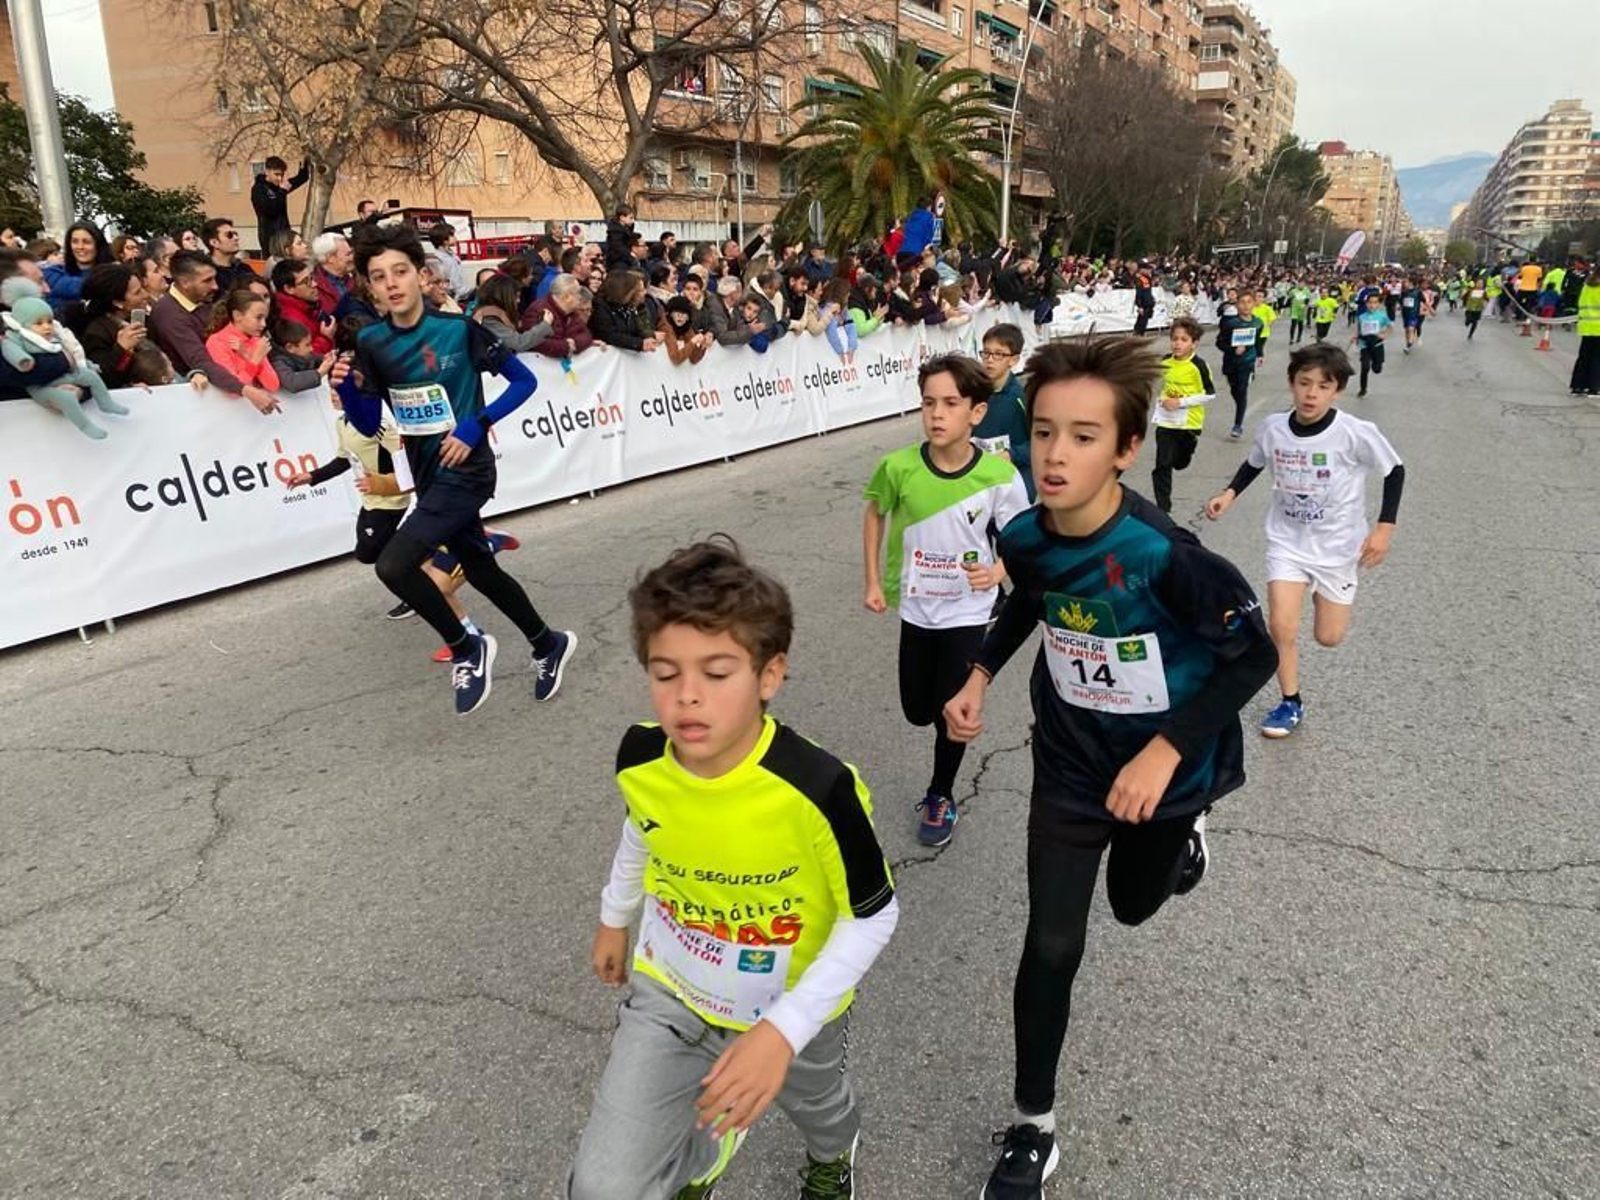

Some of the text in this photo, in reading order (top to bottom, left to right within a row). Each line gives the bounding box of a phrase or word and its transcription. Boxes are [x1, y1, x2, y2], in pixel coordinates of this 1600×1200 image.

[640, 379, 721, 427] calderón
[734, 368, 793, 410] calderón
[398, 403, 444, 419] 12185
[522, 392, 624, 448] calderón
[125, 438, 318, 522] calderón
[21, 536, 89, 560] desde 1949
[1055, 635, 1089, 650] NOCHE
[1091, 641, 1105, 652] DE
[1070, 658, 1116, 688] 14
[666, 862, 799, 885] SU SEGURIDAD
